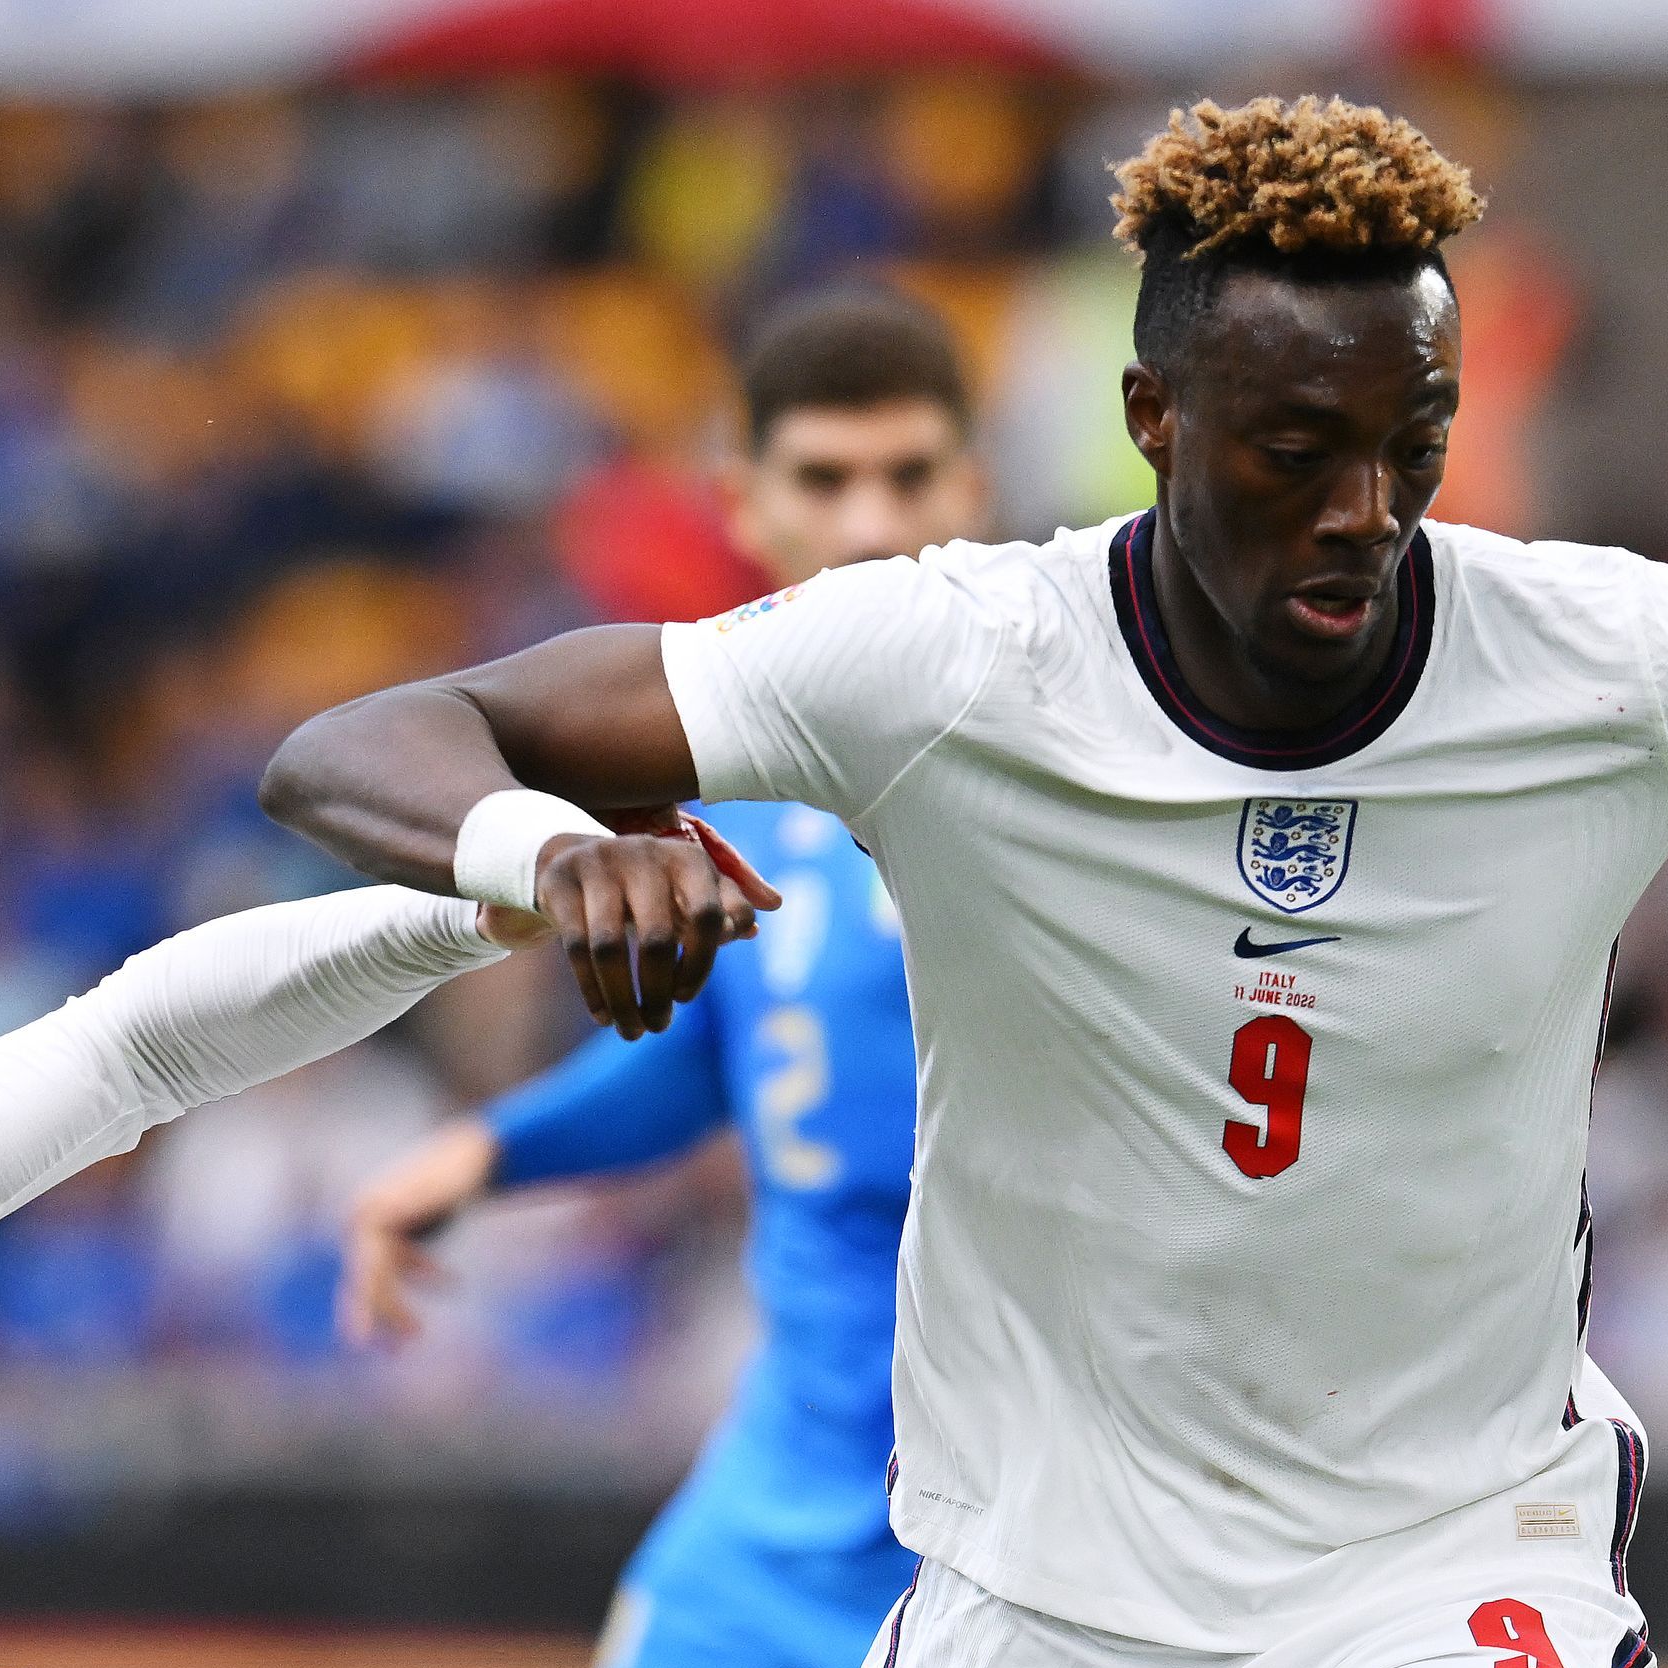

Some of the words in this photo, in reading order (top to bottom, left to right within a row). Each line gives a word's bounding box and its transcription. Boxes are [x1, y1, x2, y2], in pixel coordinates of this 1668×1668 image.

[1259, 972, 1296, 988] ITALY
[1235, 986, 1244, 1000] 11
[1249, 988, 1282, 1005] JUNE
[1286, 993, 1316, 1009] 2022
[756, 1004, 843, 1194] 2
[1222, 1014, 1313, 1179] 9
[918, 1489, 942, 1501] NIKE
